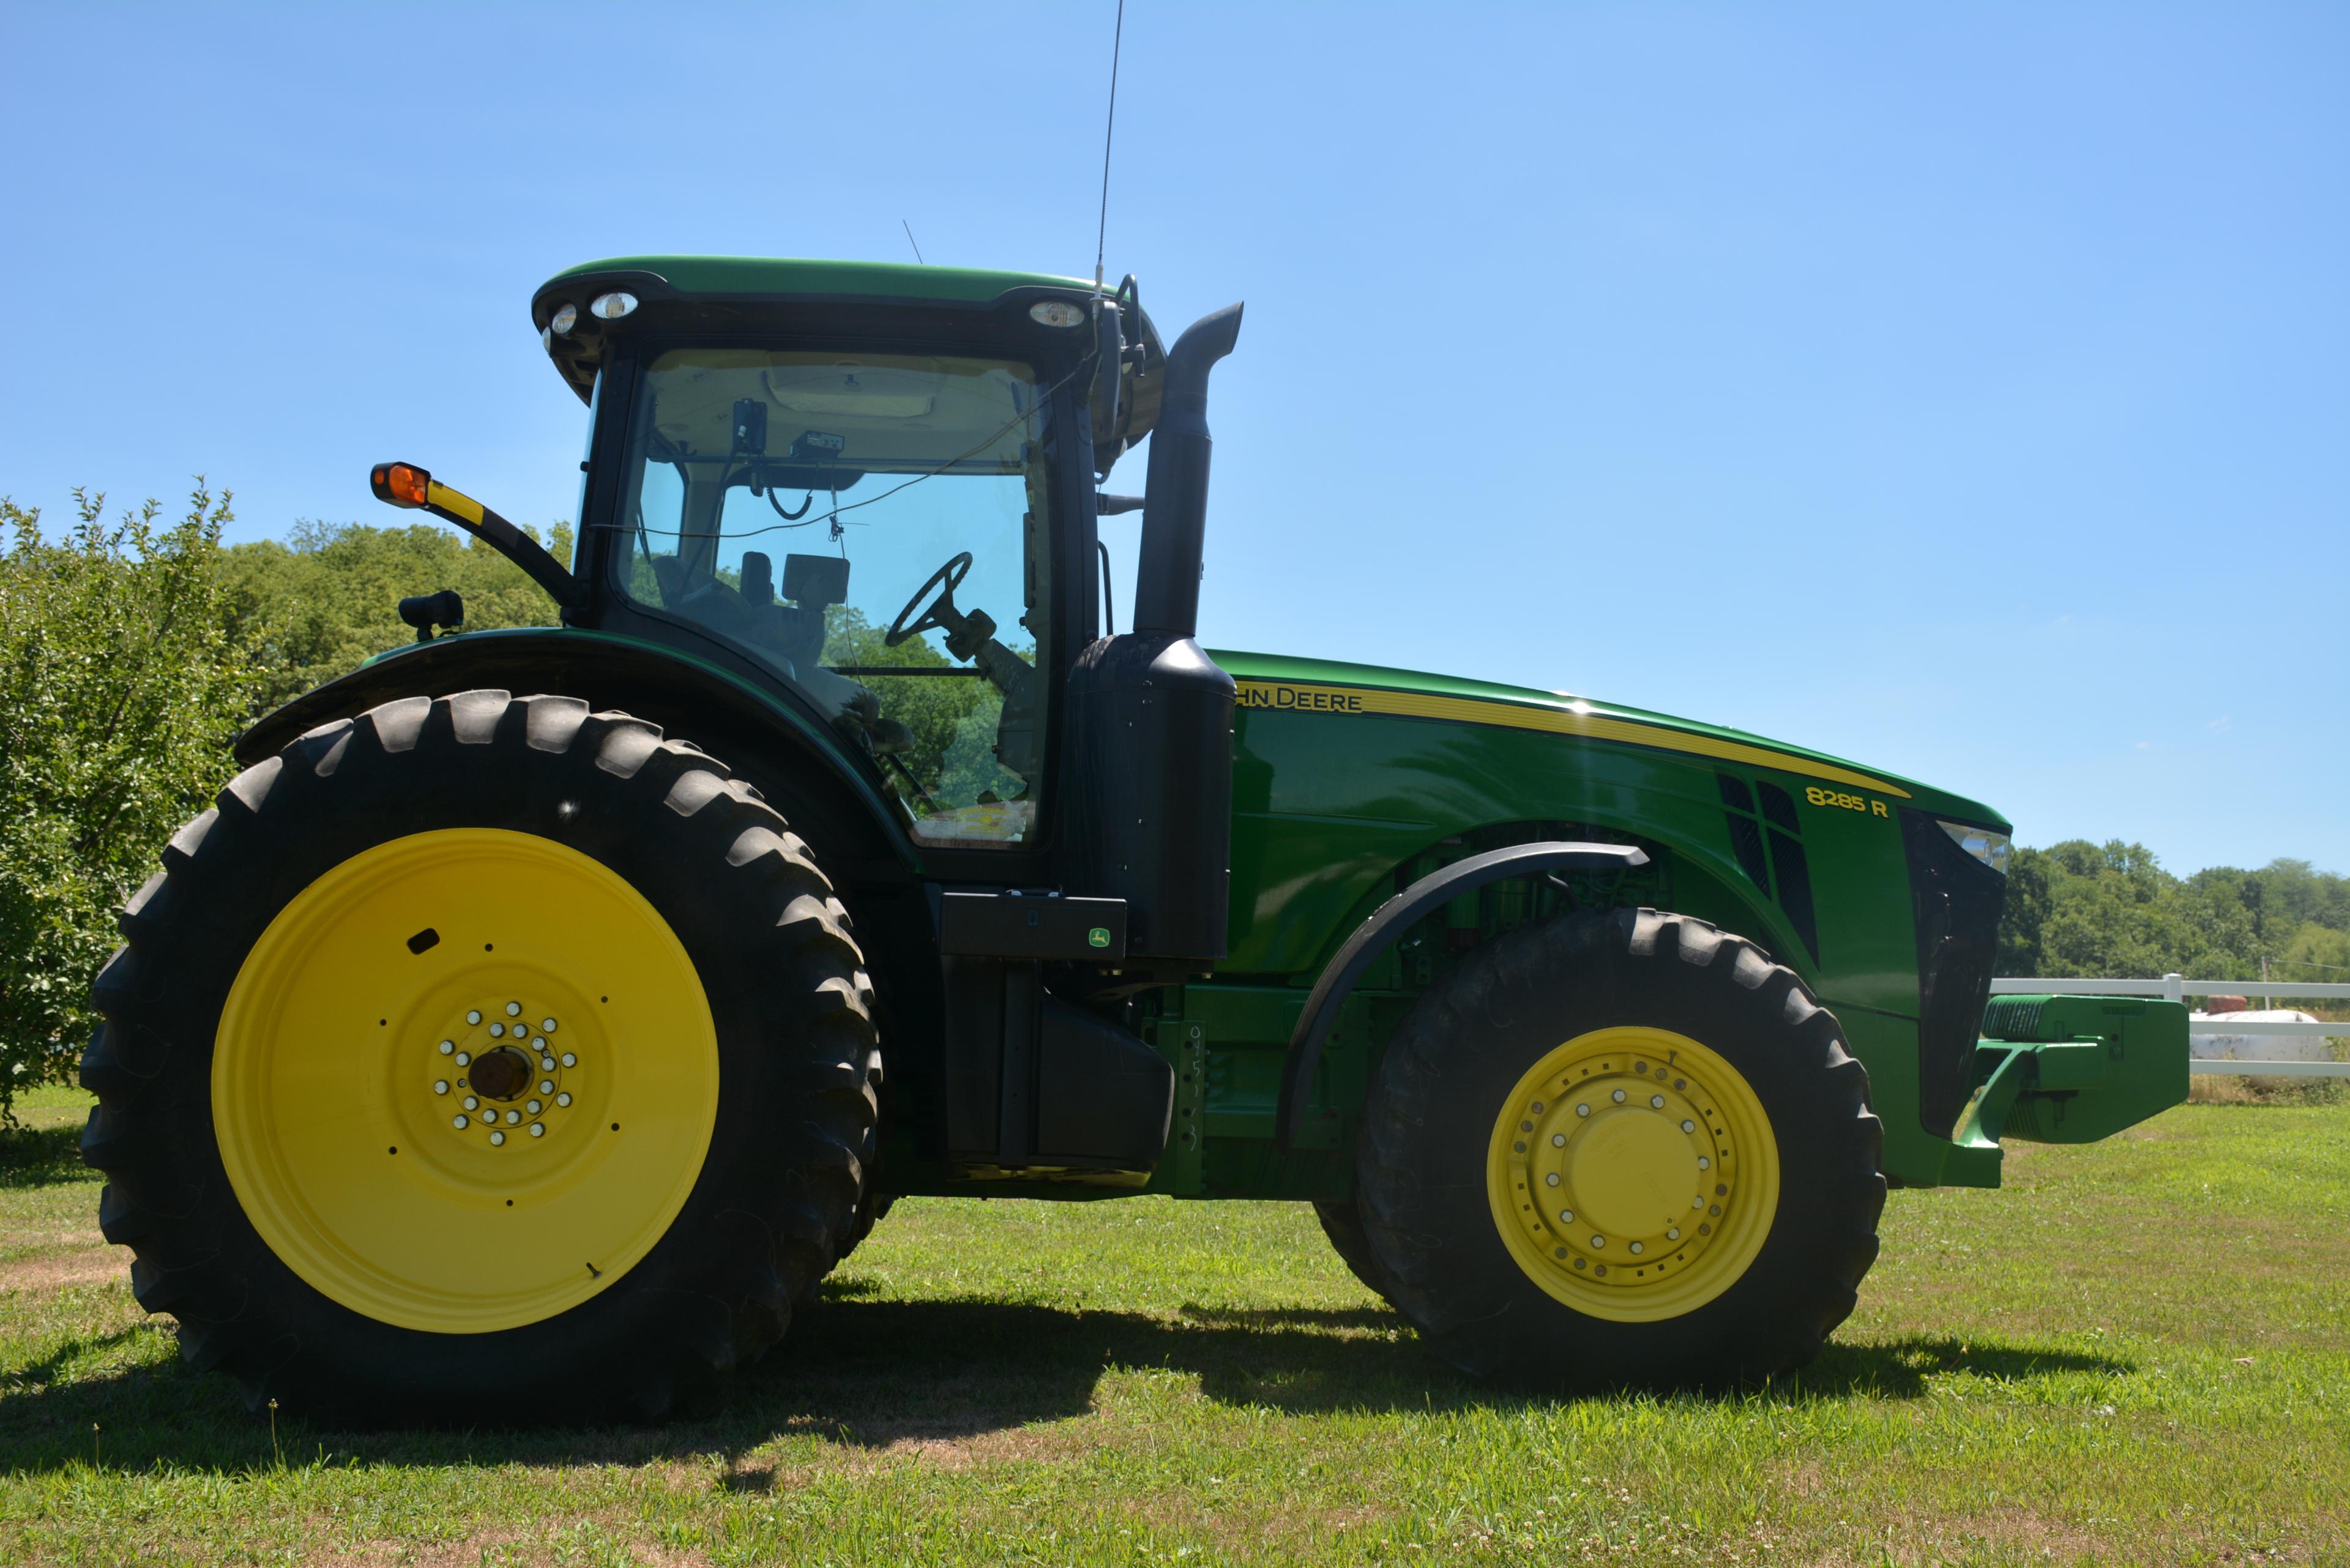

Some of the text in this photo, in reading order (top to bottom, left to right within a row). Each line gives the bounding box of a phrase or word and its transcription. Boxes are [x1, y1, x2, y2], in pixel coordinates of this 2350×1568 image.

[1277, 687, 1362, 711] DEERE
[1806, 786, 1889, 818] 8285 R
